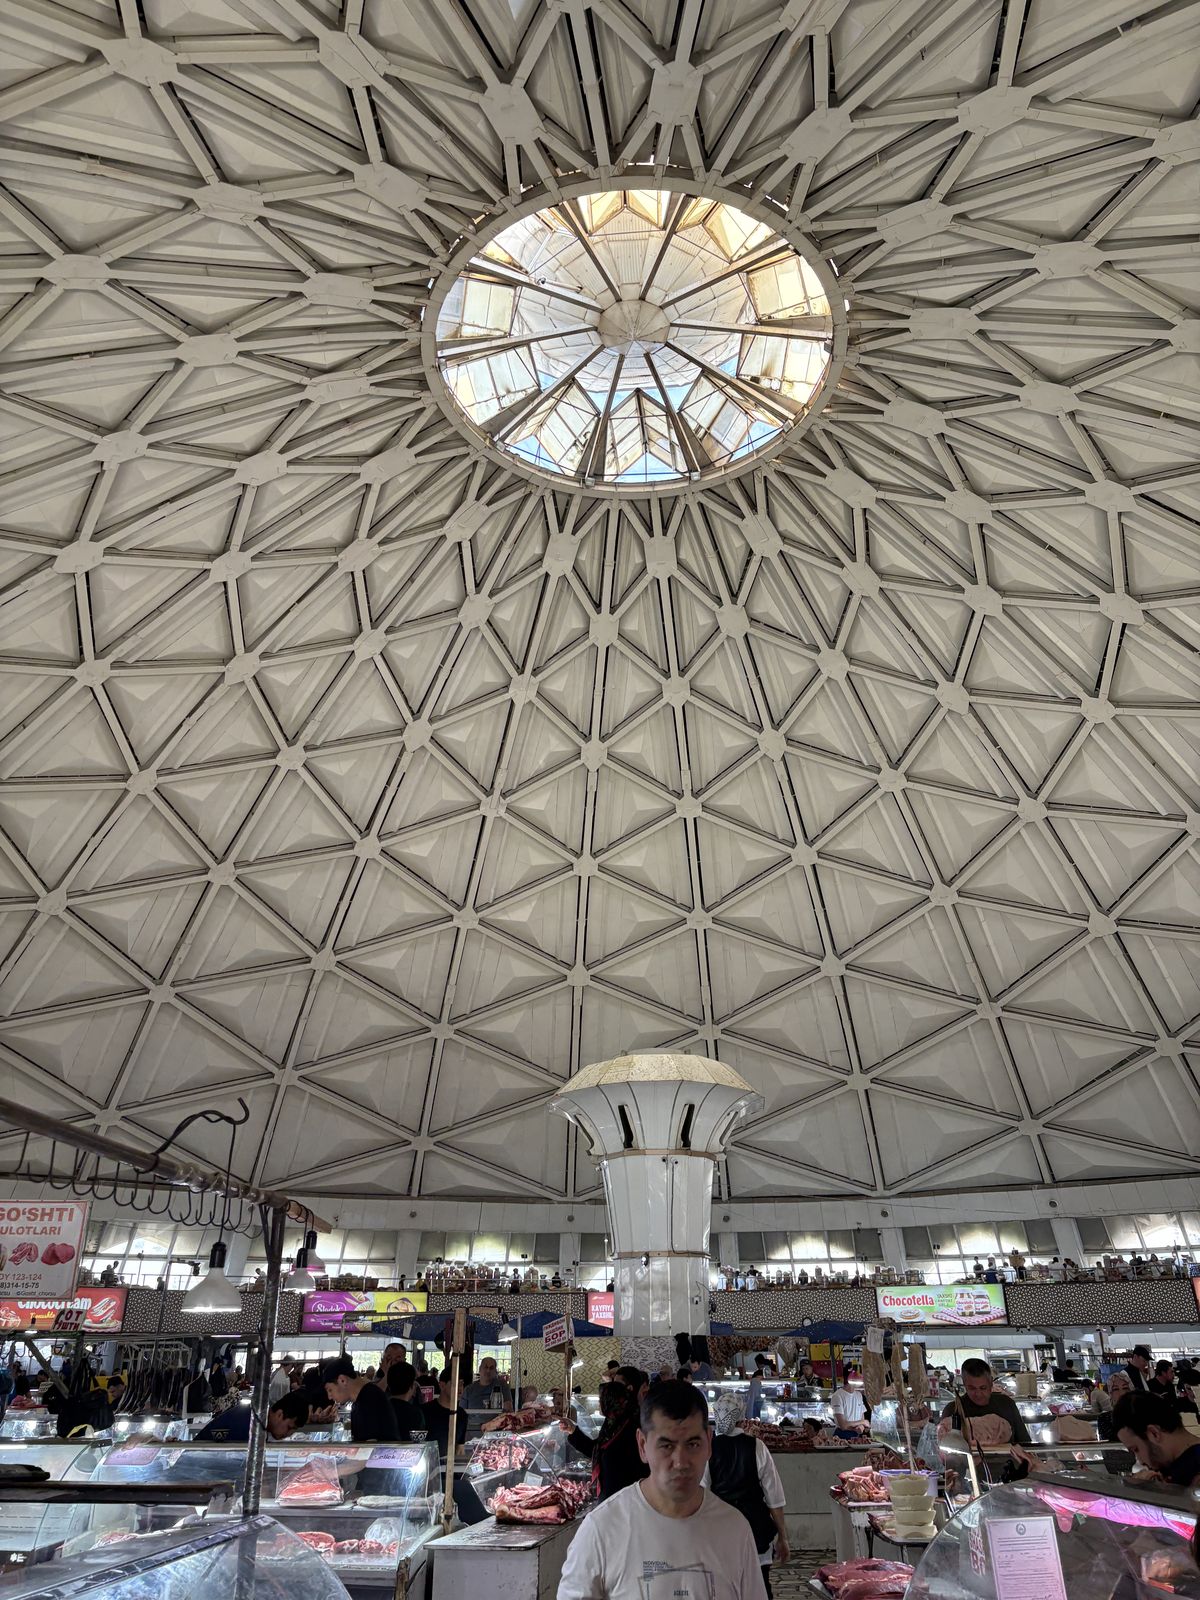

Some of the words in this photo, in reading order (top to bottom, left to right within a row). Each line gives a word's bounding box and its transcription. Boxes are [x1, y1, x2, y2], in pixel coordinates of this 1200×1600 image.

[0, 1226, 60, 1235] ULOTLARI
[12, 1273, 42, 1281] 123-124
[883, 1295, 934, 1306] Chocotella
